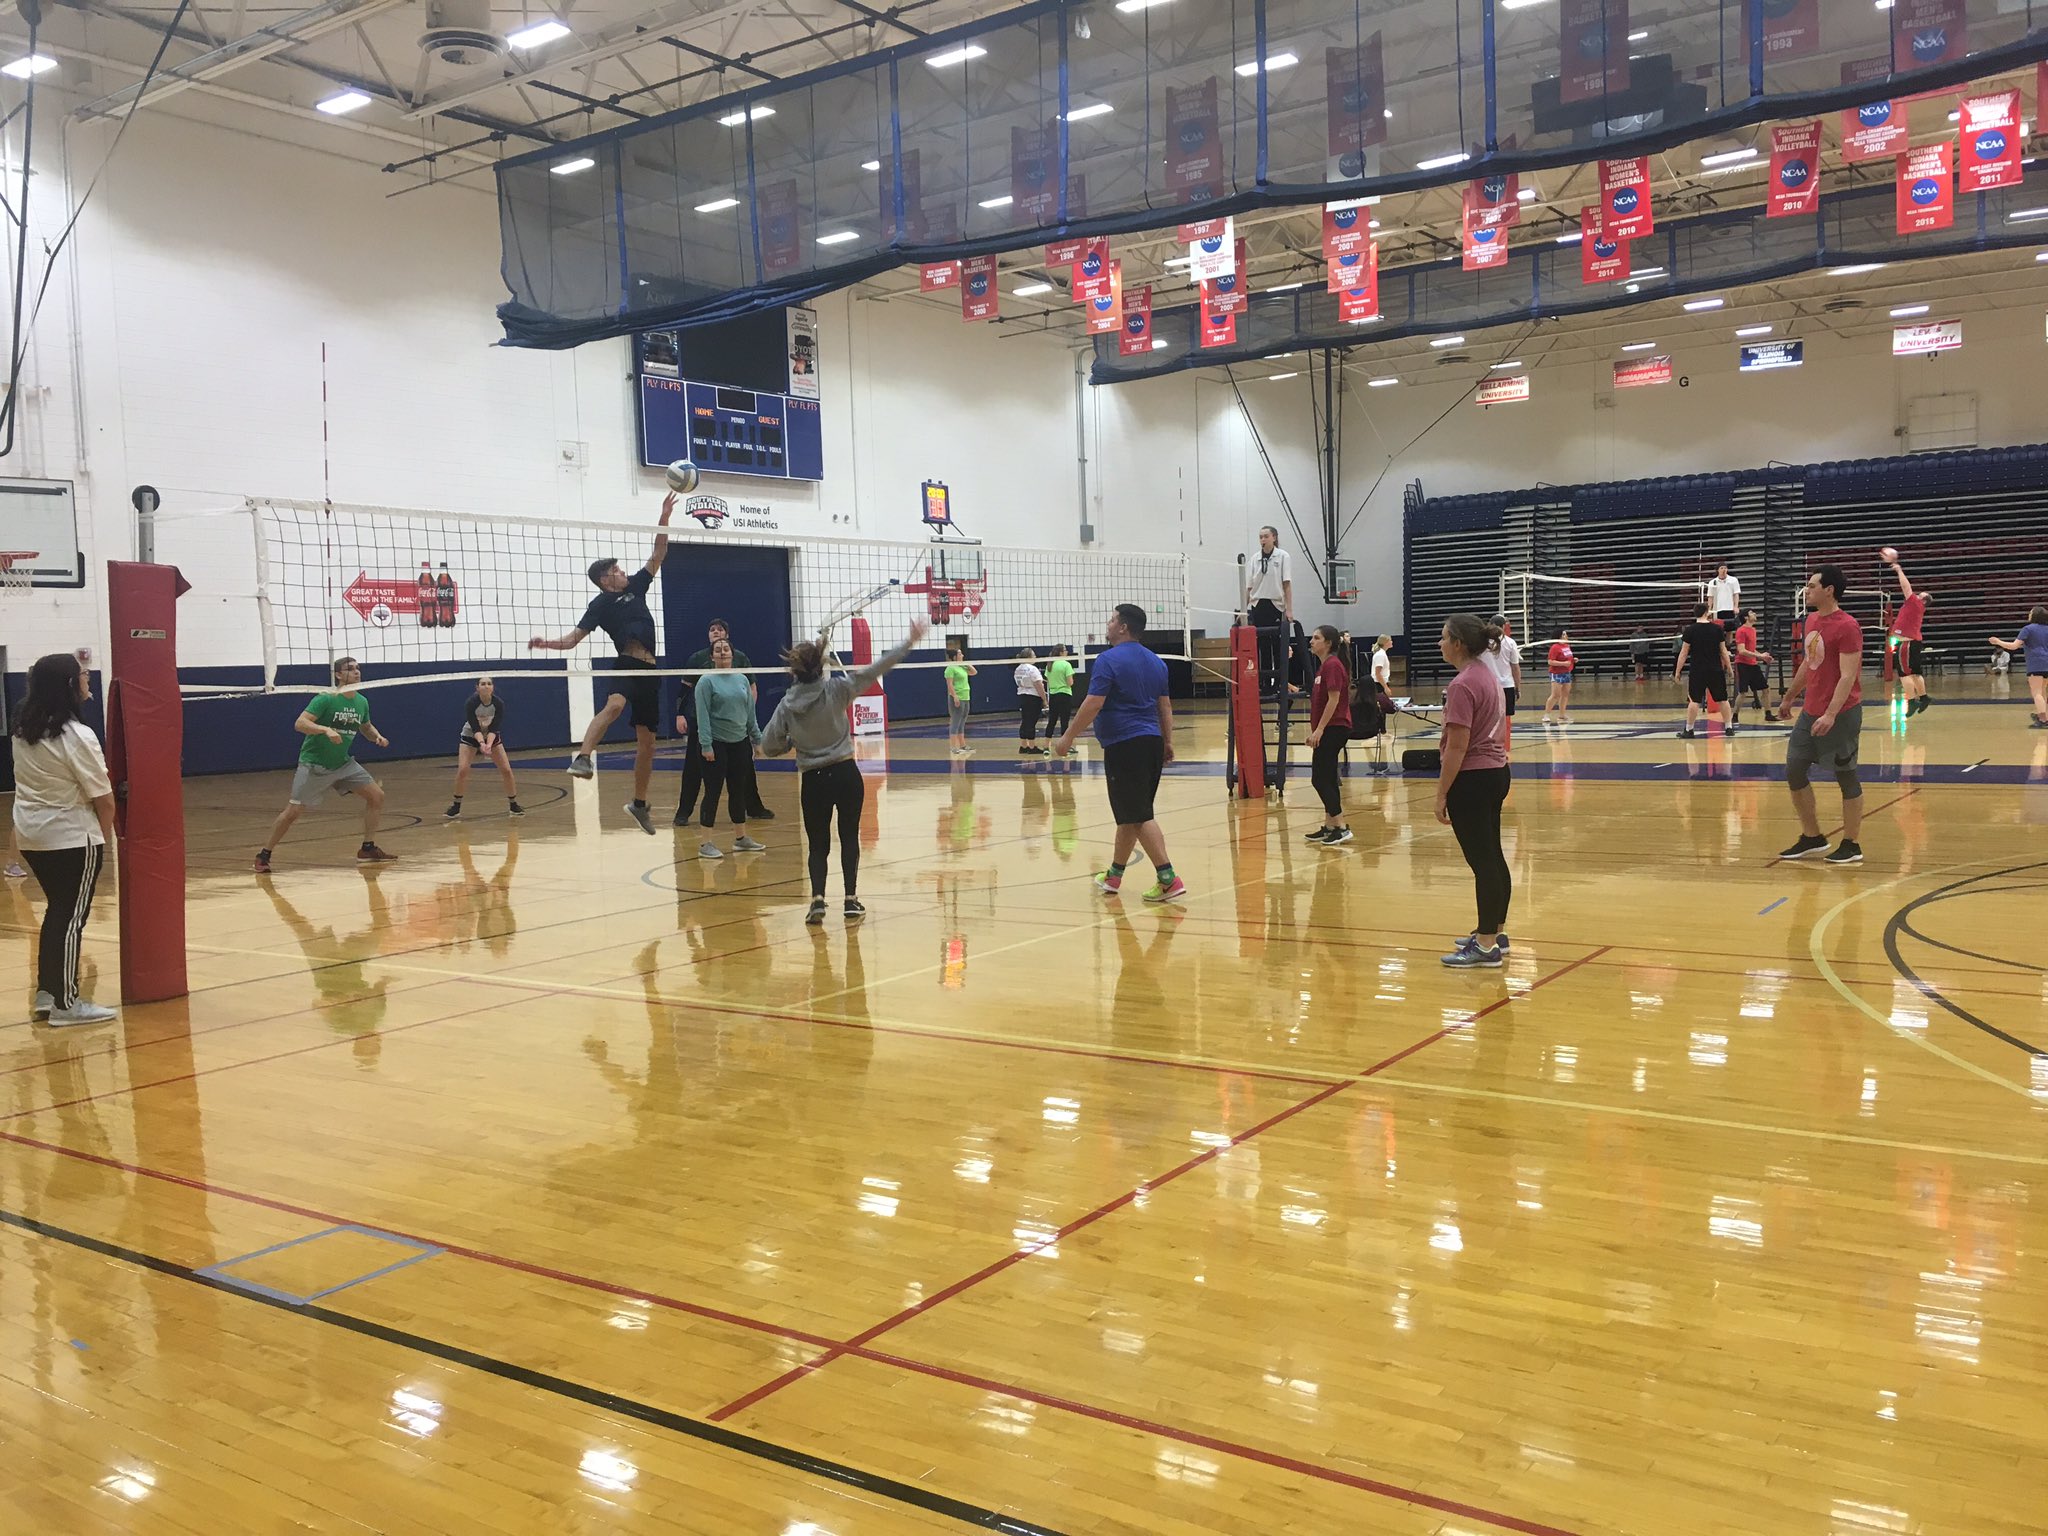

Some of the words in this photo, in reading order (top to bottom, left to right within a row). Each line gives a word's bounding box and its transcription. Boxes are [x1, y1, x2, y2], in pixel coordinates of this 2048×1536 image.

[1968, 93, 2011, 106] SOUTHERN
[1859, 105, 1890, 118] NCAA
[1778, 124, 1815, 136] SOUTHERN
[1965, 117, 2015, 133] BASKETBALL
[1782, 132, 1810, 143] INDIANA
[1774, 140, 1817, 152] VOLLEYBALL
[1864, 142, 1886, 154] 2002
[1975, 139, 2005, 151] NCAA
[1906, 145, 1943, 157] SOUTHERN
[1910, 153, 1939, 164] INDIANA
[1610, 162, 1637, 174] INDIANA
[1908, 160, 1942, 172] WOMEN'S
[1609, 168, 1640, 181] WOMEN'S
[1781, 168, 1807, 178] NCAA
[1903, 167, 1947, 180] BASKETBALL
[1604, 176, 1645, 190] BASKETBALL
[1980, 174, 2001, 184] 2011
[1912, 186, 1938, 197] NCAA
[1613, 195, 1638, 207] NCAA
[1783, 201, 1802, 211] 2010
[1335, 210, 1356, 220] NCAA
[1915, 217, 1935, 227] 2015
[1194, 225, 1210, 235] 1997
[1618, 226, 1636, 236] 2010
[1201, 236, 1222, 245] NCAA
[1338, 242, 1354, 251] 2001
[1083, 259, 1101, 269] NCAA
[1476, 255, 1493, 263] 2007
[963, 264, 992, 274] BASKETBALL
[1205, 265, 1220, 274] 2001
[1598, 268, 1614, 277] 2014
[970, 281, 988, 289] NCAA
[1217, 276, 1235, 285] NCAA
[1128, 320, 1144, 328] NCAA
[1900, 334, 1956, 348] UNIVERSITY
[1748, 343, 1785, 354] UNIVERSITY
[1786, 342, 1796, 350] OF
[1757, 349, 1785, 359] ILLINOIS
[1751, 355, 1792, 366] SPRINGFIELD
[1616, 368, 1670, 384] INDIANAPOLIS
[1679, 376, 1689, 387] G
[647, 378, 658, 388] PLY
[661, 381, 668, 390] FL
[669, 381, 681, 392] PTS
[1480, 378, 1526, 391] BELLARMINE
[1481, 388, 1523, 399] UNIVERSITY
[788, 399, 799, 409] PLY
[800, 401, 807, 410] FL
[807, 402, 818, 411] PTS
[695, 407, 714, 417] HOME
[731, 416, 746, 425] PERIOD
[758, 416, 780, 426] GUEST
[693, 437, 707, 445] FOULS
[725, 441, 740, 449] PLAYER
[743, 443, 753, 451] FOUL
[769, 446, 782, 454] FOULS
[686, 501, 729, 517] INDIANA
[740, 505, 761, 515] Home
[763, 506, 770, 515] of
[733, 518, 745, 527] USI
[747, 519, 778, 530] Athletics
[351, 588, 373, 596] GREAT
[855, 704, 870, 717] PENN
[856, 712, 879, 726] STATION
